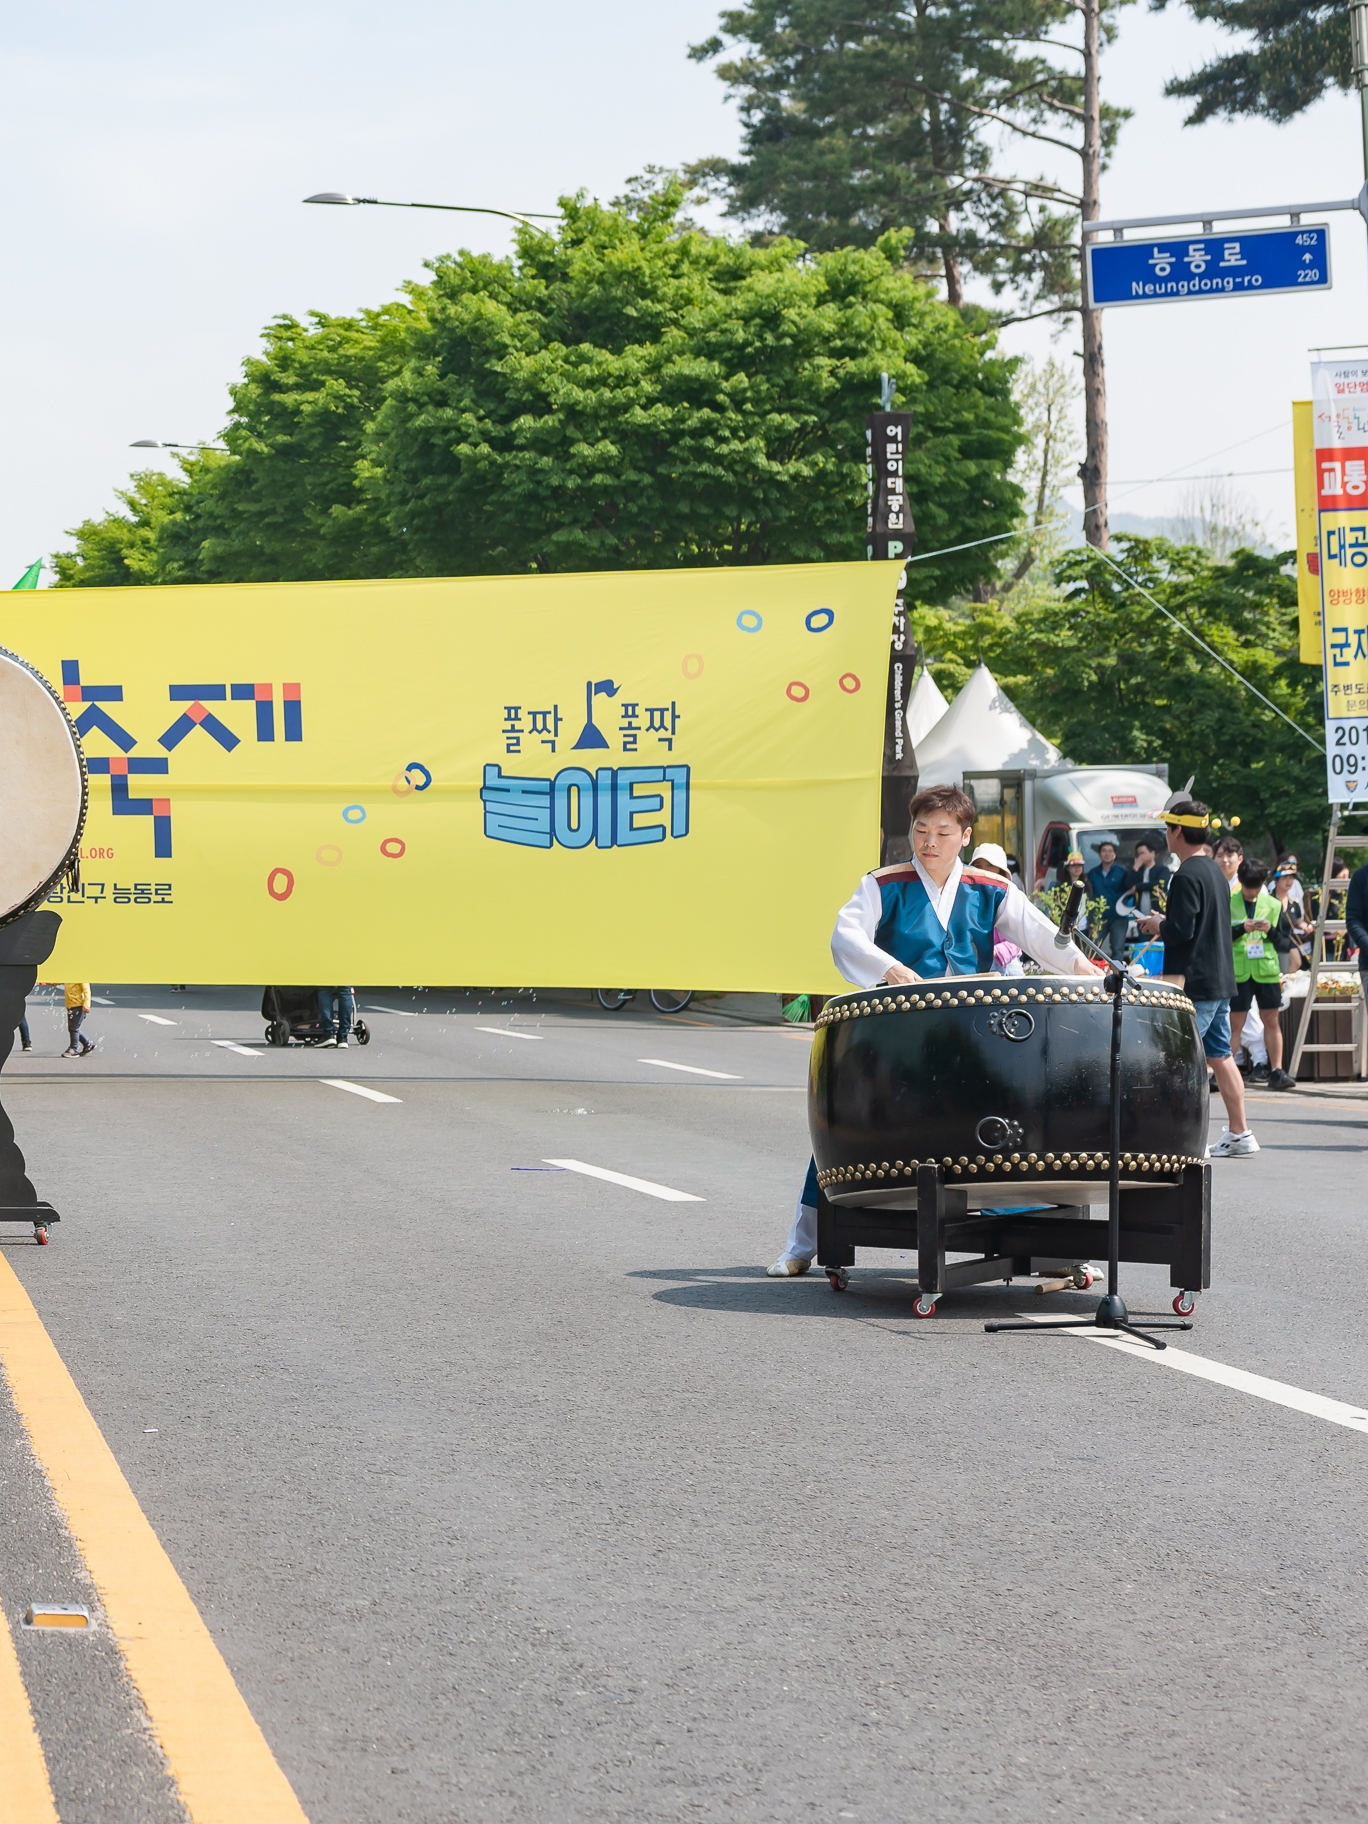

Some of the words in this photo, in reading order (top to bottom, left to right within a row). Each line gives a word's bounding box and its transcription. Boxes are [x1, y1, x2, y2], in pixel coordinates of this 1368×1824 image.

[1295, 232, 1318, 246] 452
[1148, 242, 1247, 277] 능동로
[1132, 274, 1263, 296] Neungdong-ro
[1297, 269, 1320, 283] 220
[1335, 369, 1358, 379] 사람이
[886, 425, 904, 530] 어린이대공원
[1321, 459, 1367, 496] 교통
[888, 540, 904, 559] P
[1331, 683, 1368, 696] 주변도
[502, 704, 563, 753] 폴짝
[619, 701, 681, 752] 폴짝
[895, 709, 904, 737] Grand
[895, 738, 904, 760] Park
[480, 763, 690, 849] 놀이터
[112, 882, 173, 904] 능동로
